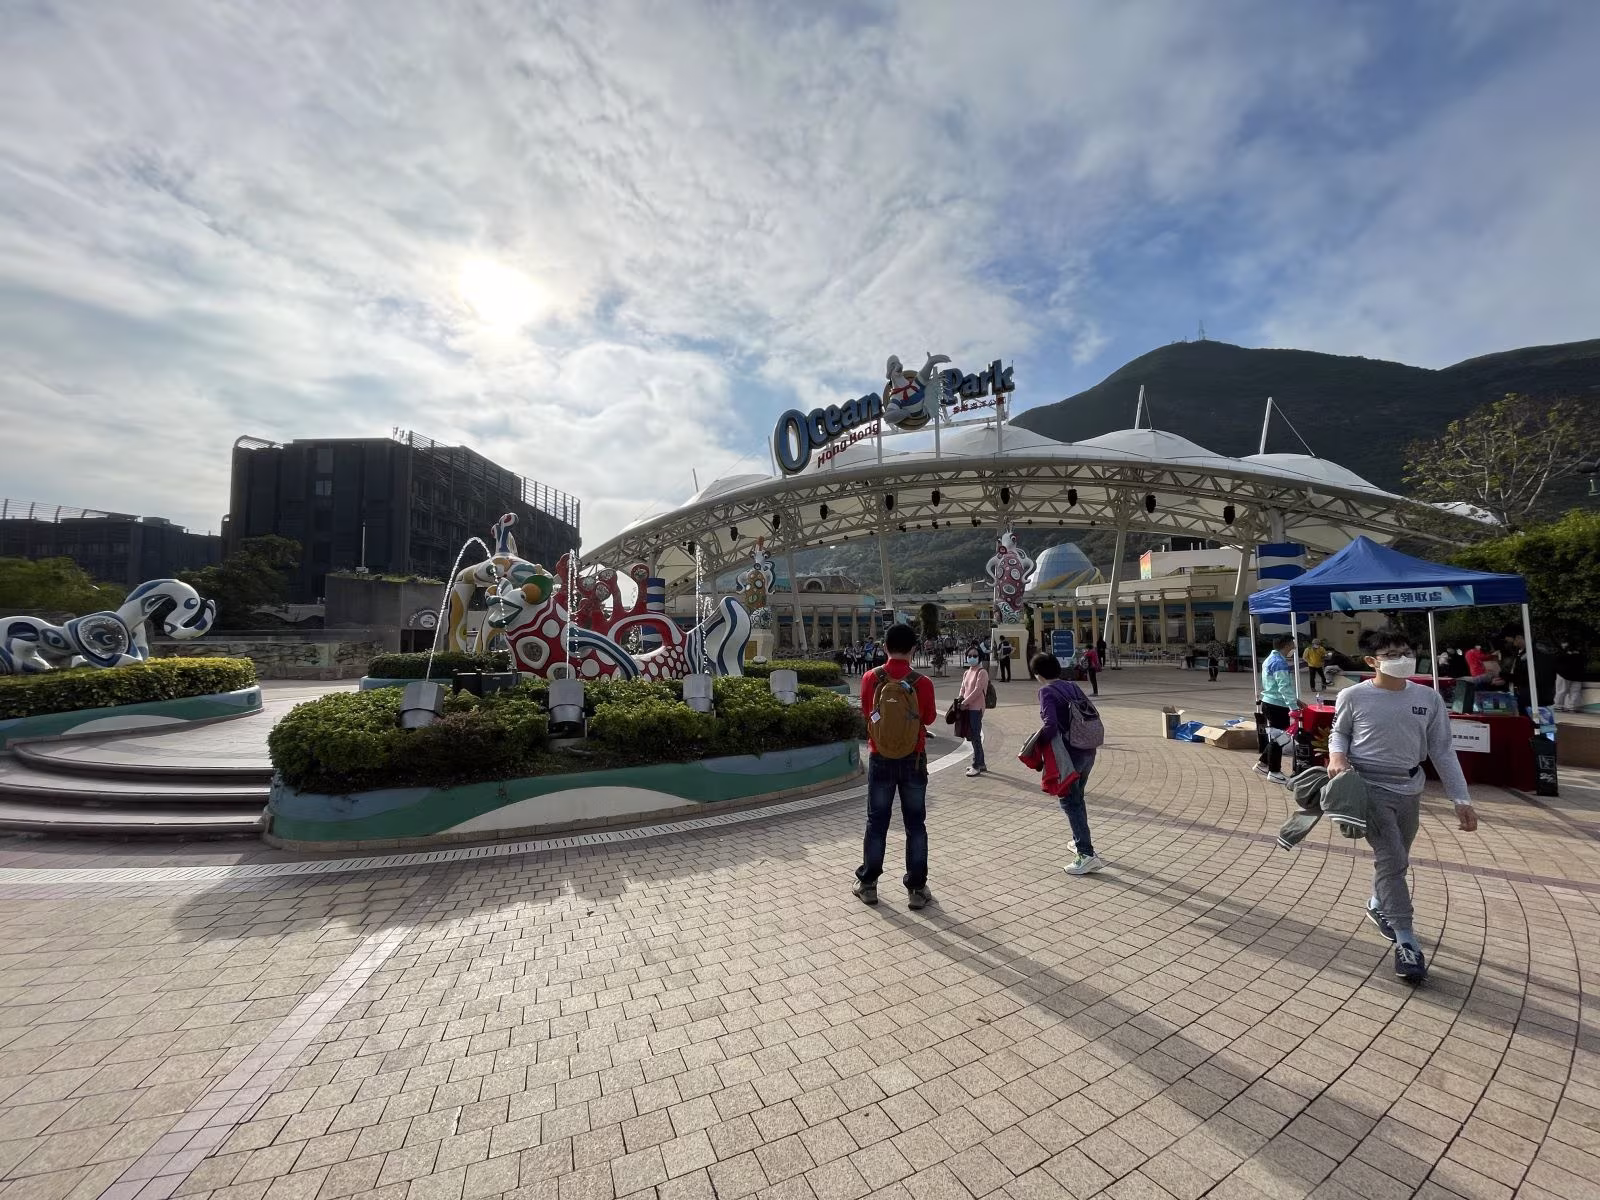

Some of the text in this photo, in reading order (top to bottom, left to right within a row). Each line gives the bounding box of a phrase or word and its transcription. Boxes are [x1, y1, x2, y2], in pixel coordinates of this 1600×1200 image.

[774, 358, 1015, 475] Ocean Park
[817, 423, 880, 469] Hong Kong
[1412, 707, 1427, 716] CAT
